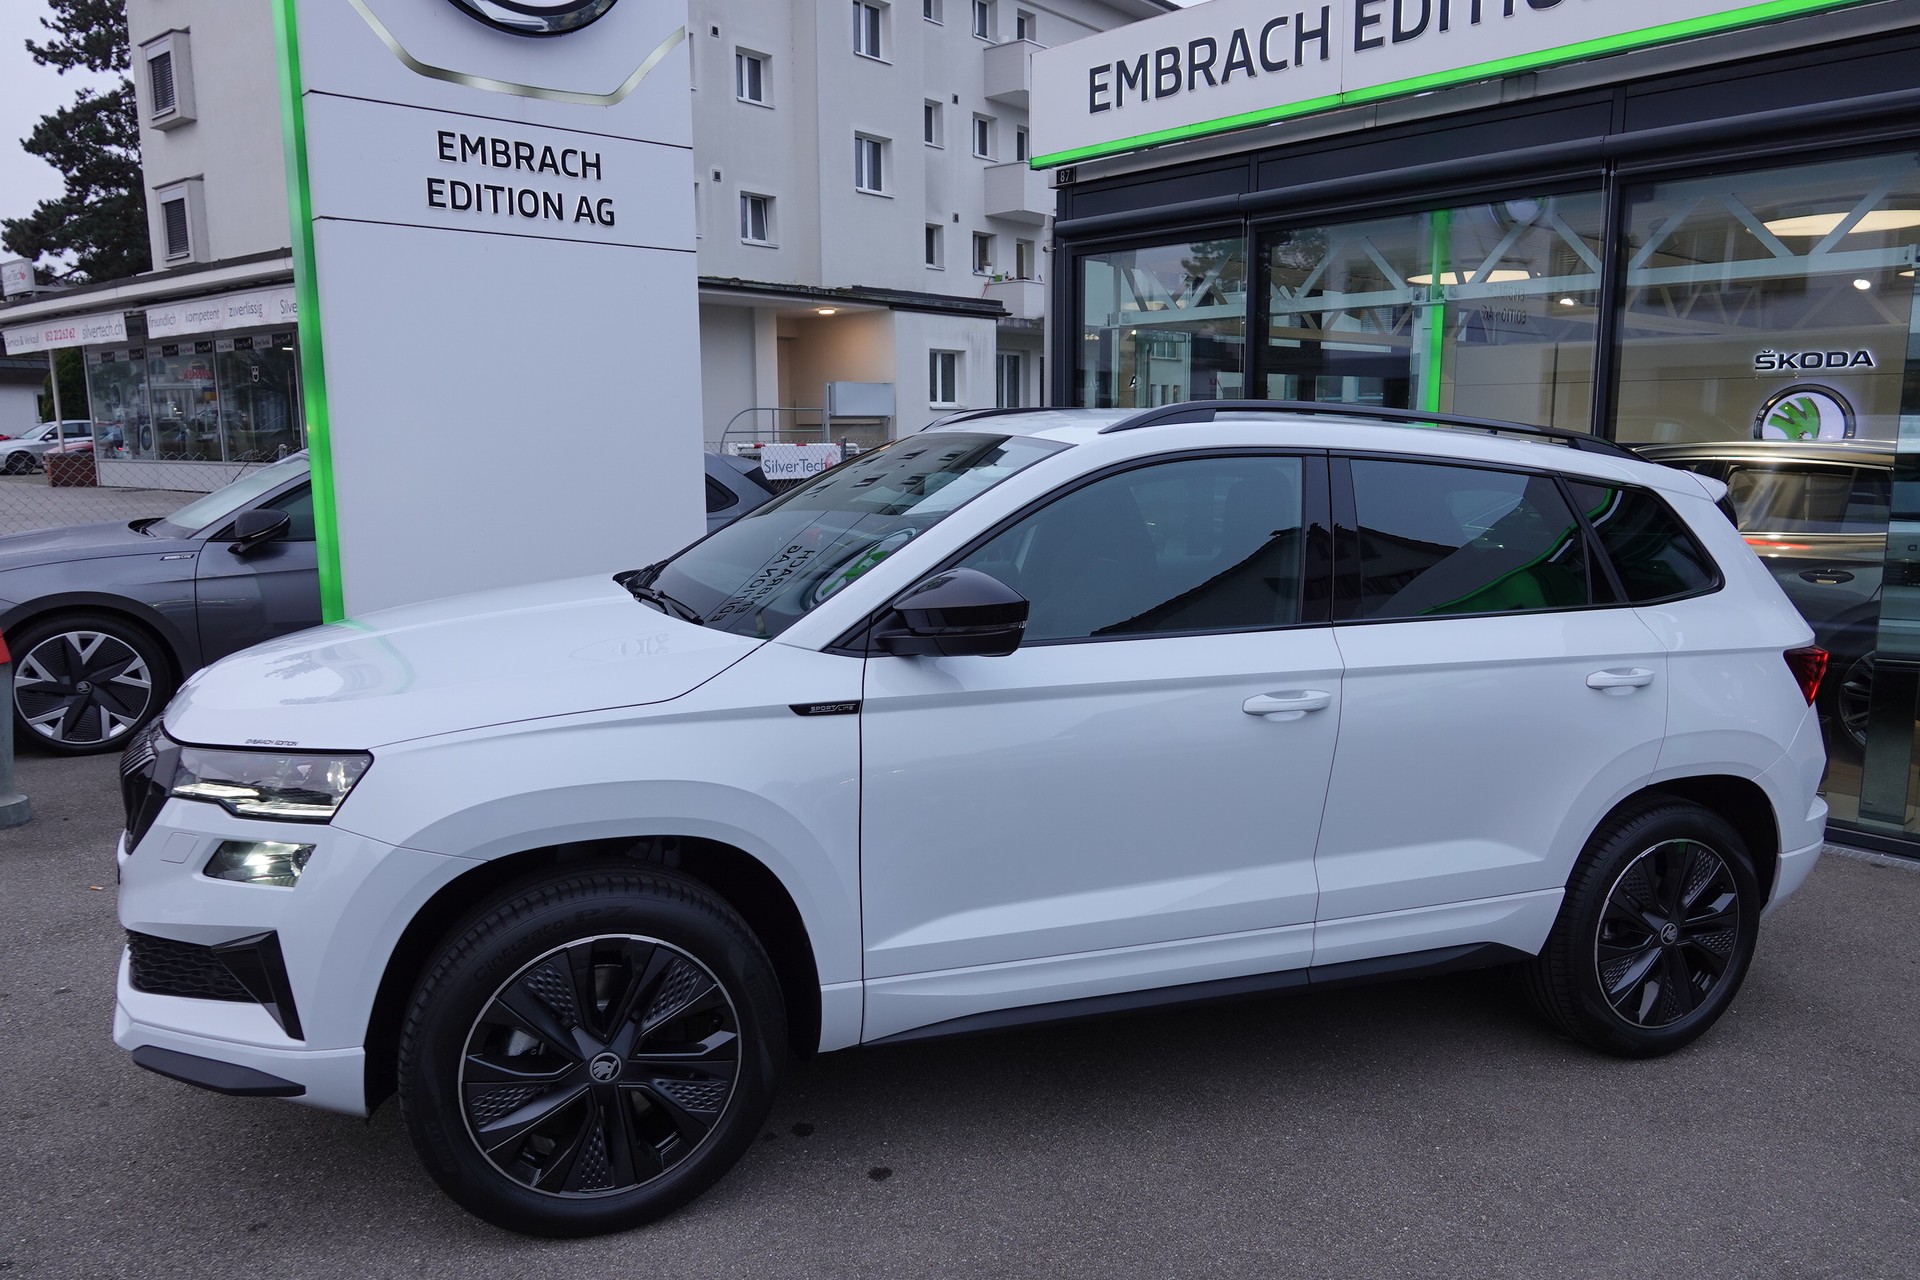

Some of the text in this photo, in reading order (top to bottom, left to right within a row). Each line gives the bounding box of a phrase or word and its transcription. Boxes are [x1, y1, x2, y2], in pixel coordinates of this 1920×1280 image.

[1088, 4, 1331, 115] EMBRACH
[436, 129, 602, 181] EMBRACH
[1060, 169, 1070, 183] 87
[426, 176, 616, 227] EDITION AG
[280, 299, 298, 315] Silve
[185, 309, 220, 324] kompetent
[1754, 349, 1874, 370] ŠKODA
[764, 458, 828, 474] SilverTech
